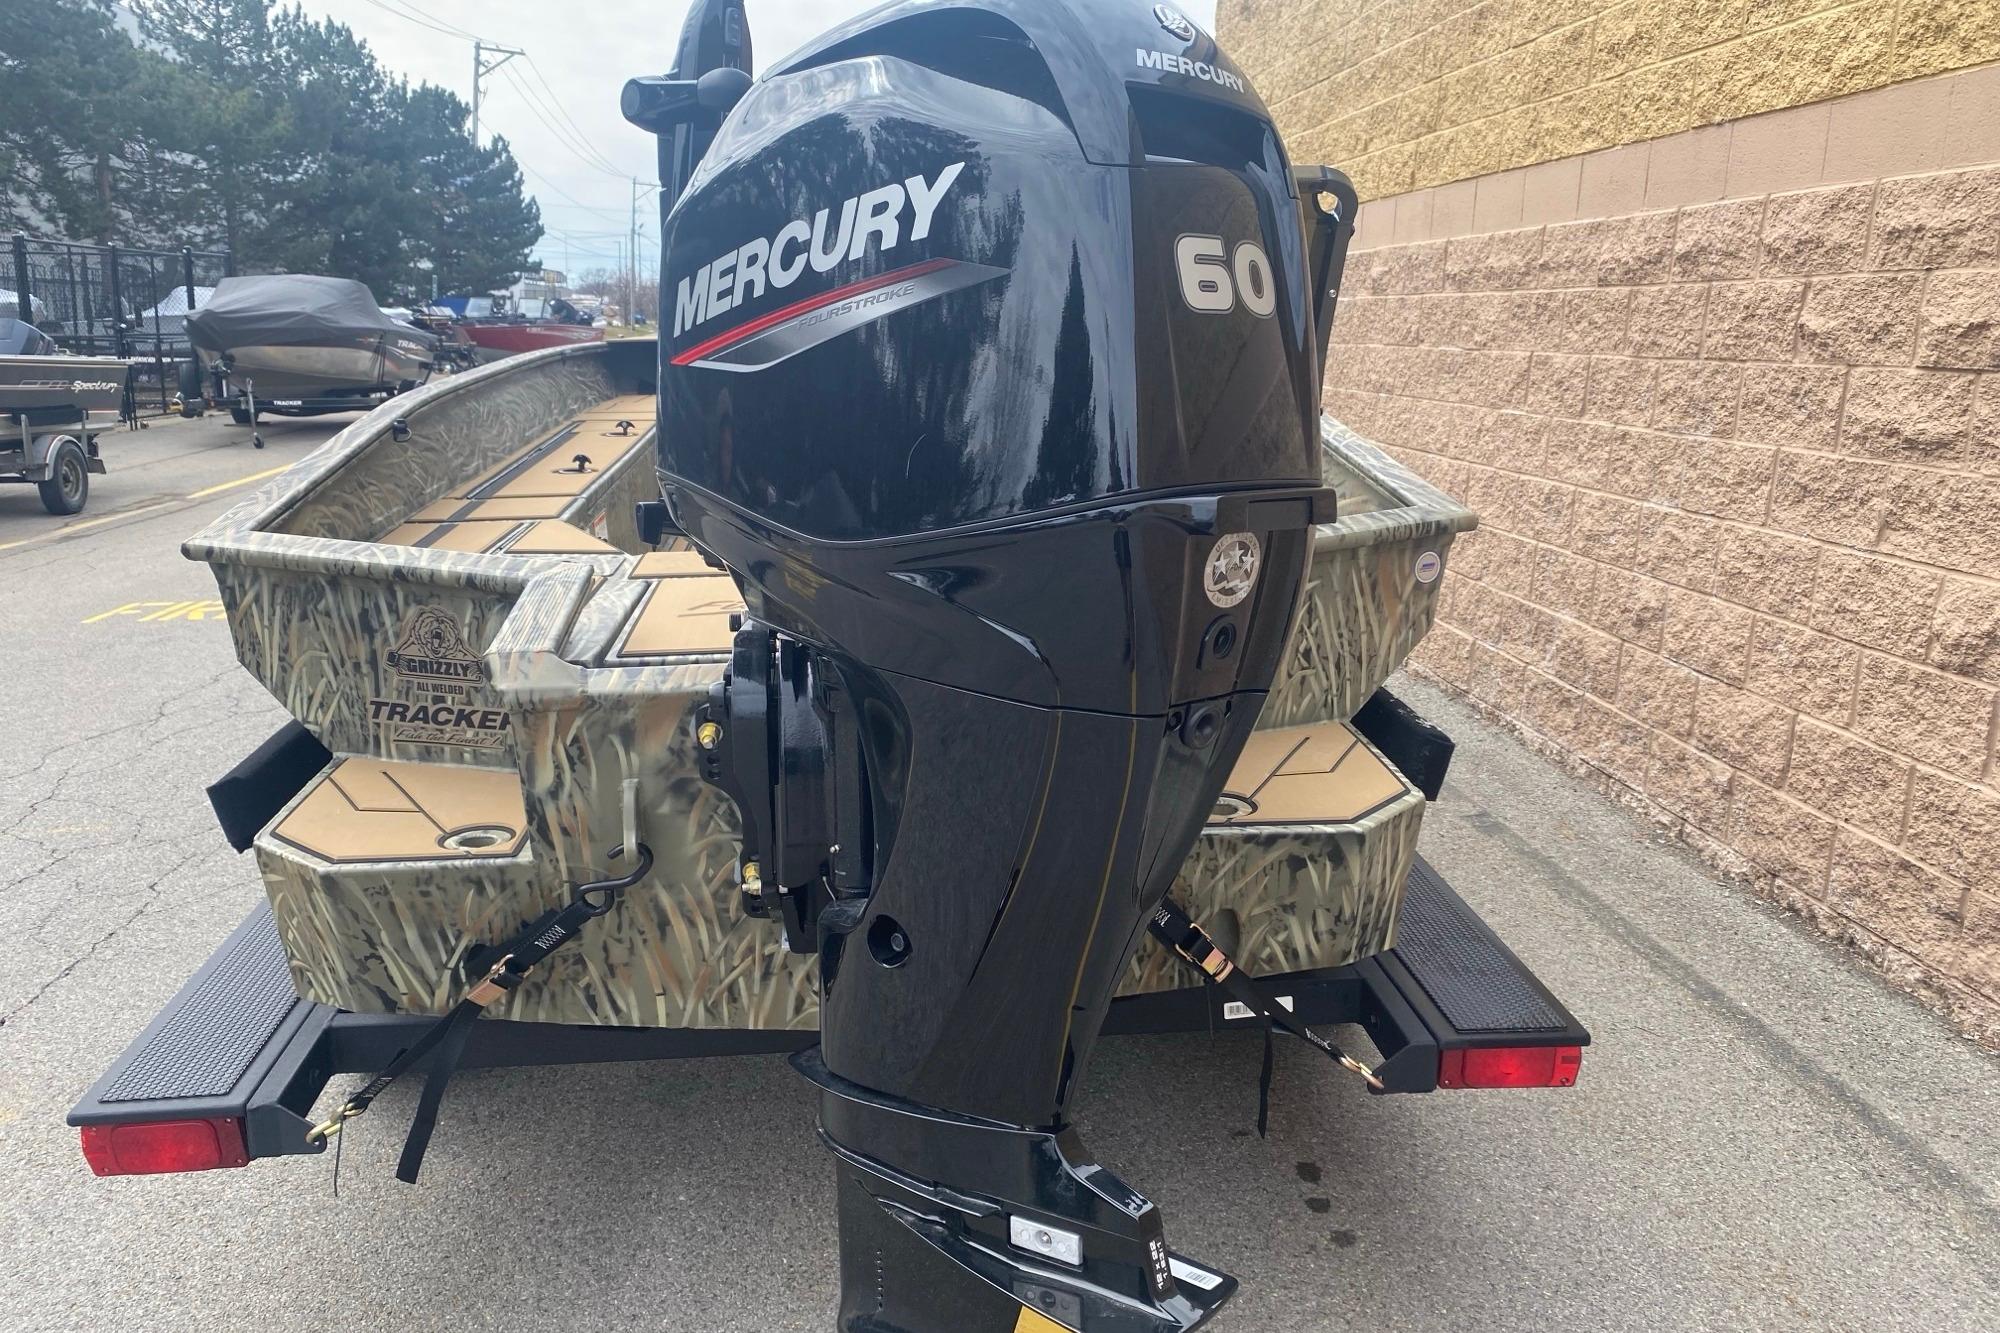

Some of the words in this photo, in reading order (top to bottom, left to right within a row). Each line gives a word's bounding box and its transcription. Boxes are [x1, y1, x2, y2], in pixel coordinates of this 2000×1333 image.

[1136, 47, 1245, 94] MERCURY
[673, 161, 966, 338] MERCURY
[1174, 232, 1277, 319] 60
[799, 282, 916, 329] FOURSTROKE
[71, 380, 117, 393] Spectrum
[407, 658, 469, 678] GRIZZLY
[416, 681, 430, 692] ALL
[431, 683, 464, 696] WELDED
[395, 728, 422, 739] Fish
[425, 732, 445, 741] the
